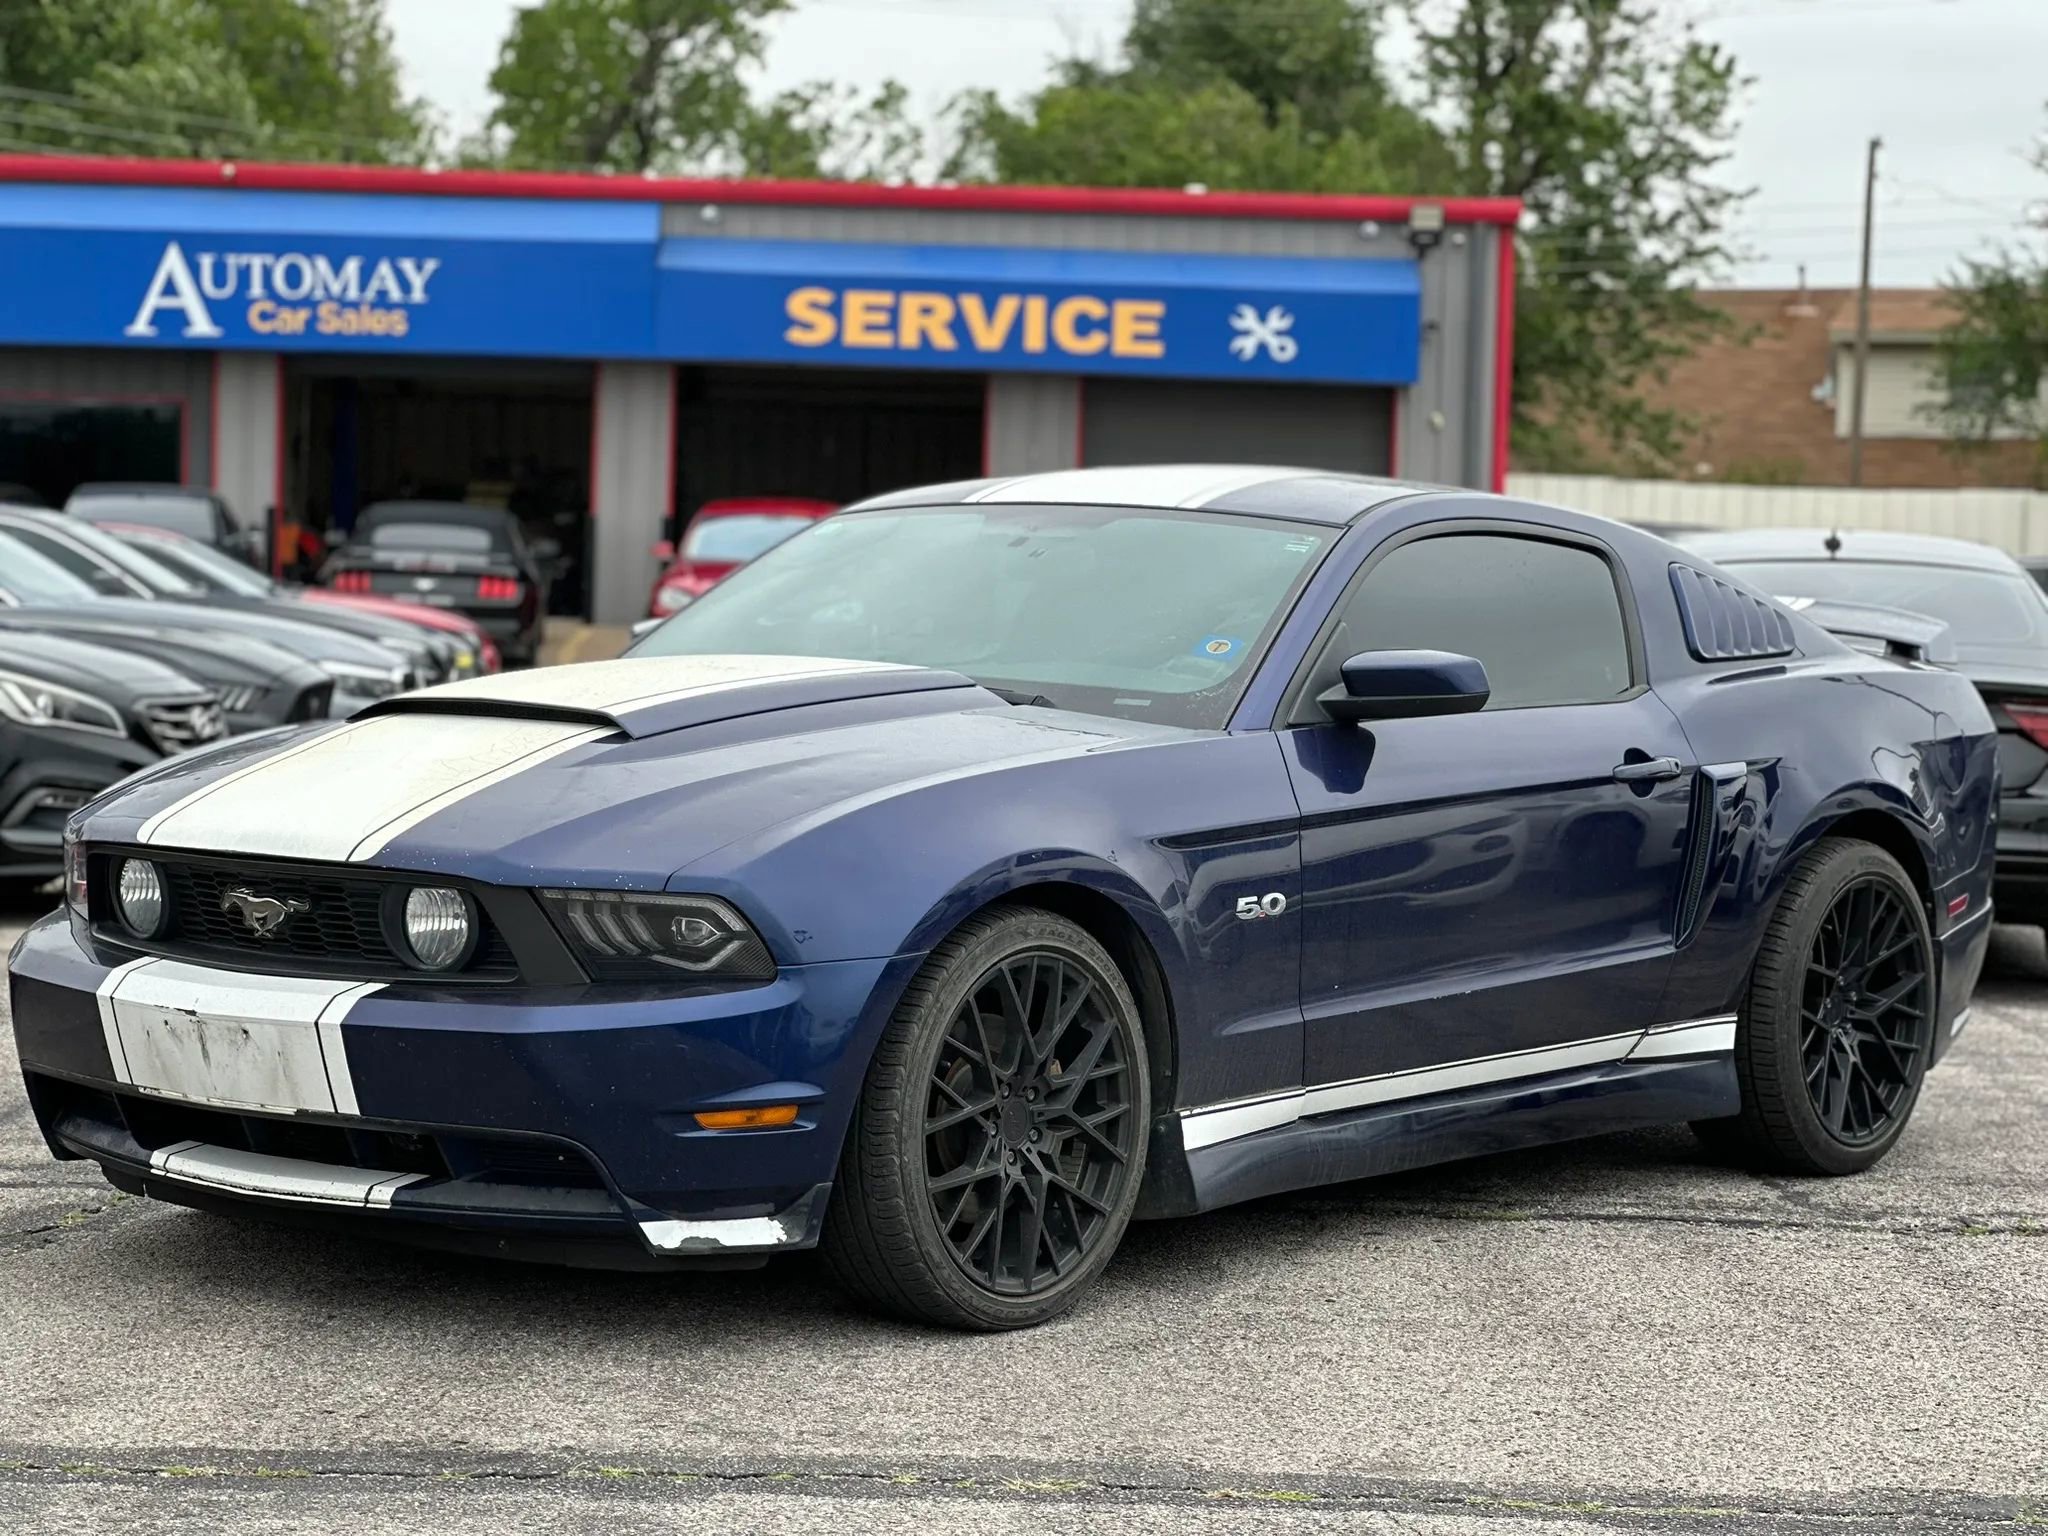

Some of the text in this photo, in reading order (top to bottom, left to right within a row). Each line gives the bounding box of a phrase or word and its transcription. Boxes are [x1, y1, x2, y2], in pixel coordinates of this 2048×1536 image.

[247, 300, 408, 337] Car Sales
[785, 287, 1165, 358] SERVICE
[1236, 892, 1287, 920] 5.0
